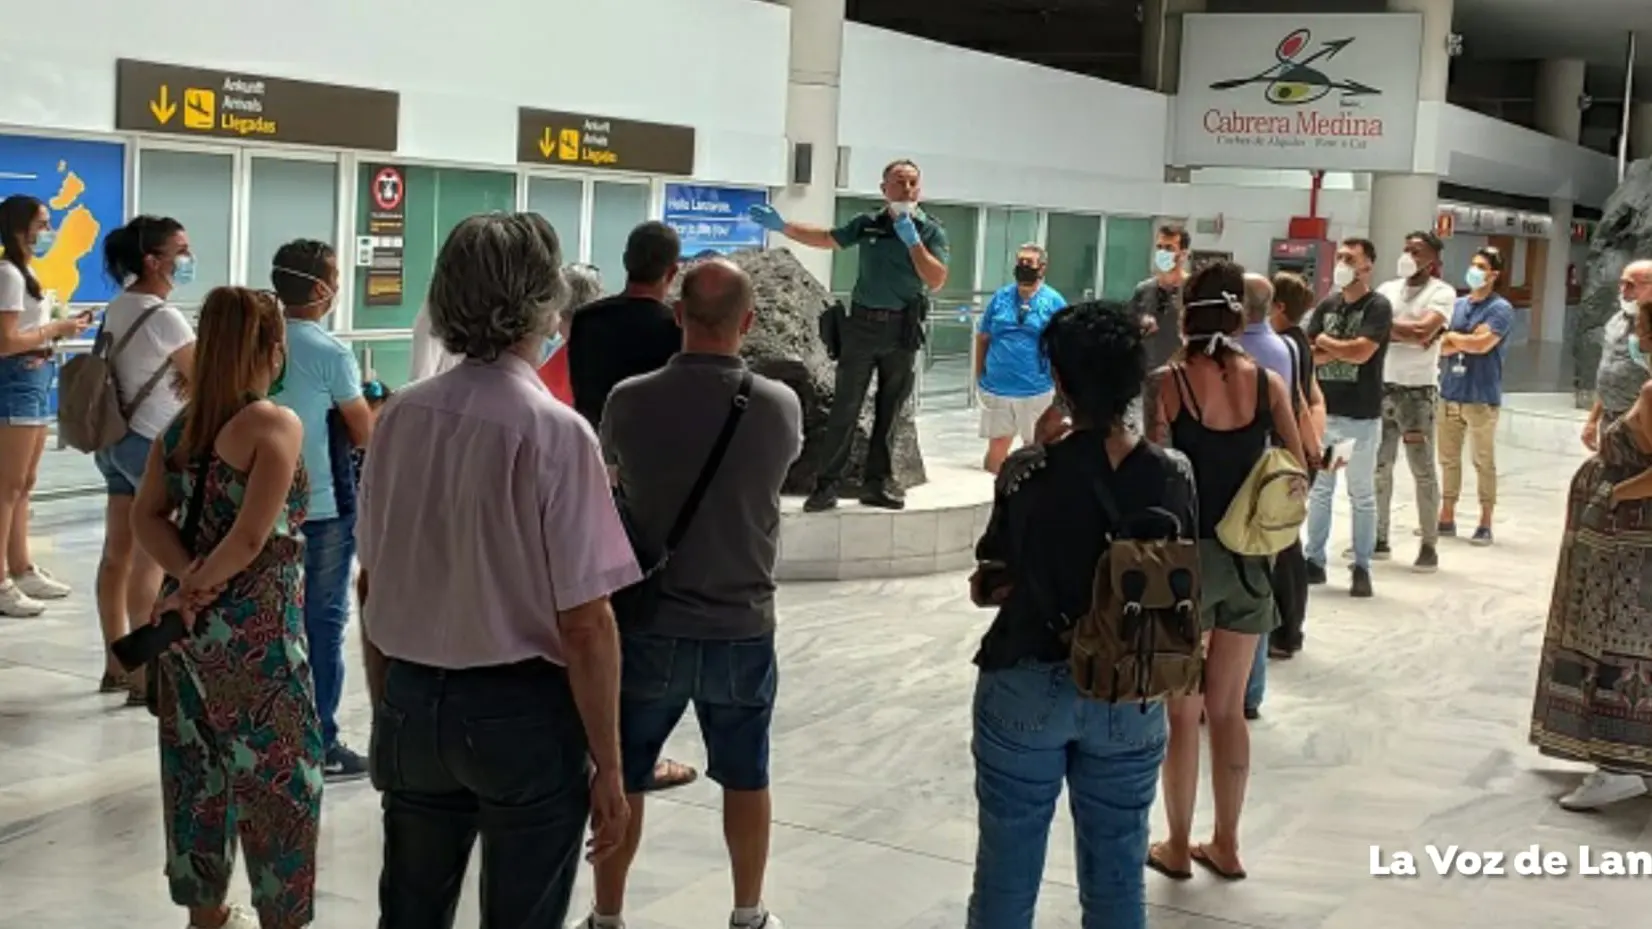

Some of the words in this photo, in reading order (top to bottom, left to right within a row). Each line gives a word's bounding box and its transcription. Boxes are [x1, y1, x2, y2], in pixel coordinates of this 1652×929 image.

[221, 113, 276, 134] Llegadas
[1203, 108, 1290, 134] Cabrera
[1296, 110, 1383, 136] Medina
